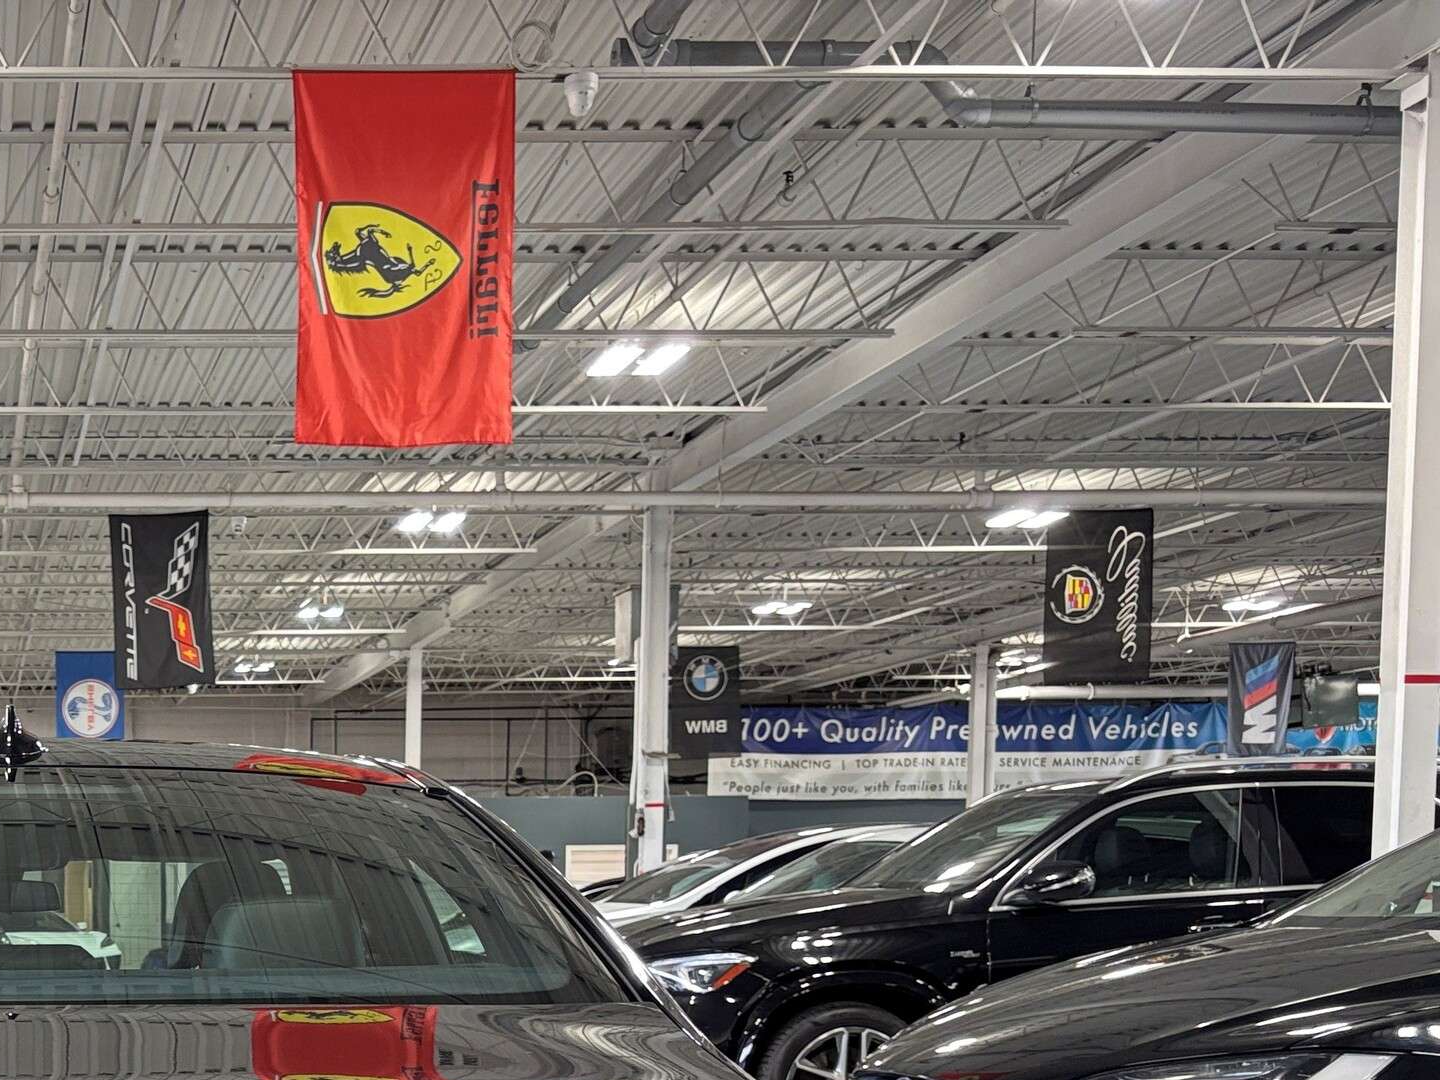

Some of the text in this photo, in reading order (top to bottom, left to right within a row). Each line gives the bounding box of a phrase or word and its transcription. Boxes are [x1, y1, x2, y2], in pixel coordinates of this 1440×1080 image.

[121, 522, 138, 681] CORVETTE
[741, 717, 809, 743] 100+
[820, 715, 920, 749] Quality
[1088, 711, 1199, 741] Vehicles
[730, 758, 760, 769] EASY
[764, 759, 831, 770] FINANCING
[855, 759, 879, 769] TOP
[883, 757, 935, 769] TRADE-IN
[999, 757, 1048, 768] SERVICE
[1052, 756, 1142, 769] MAINTENANCE
[776, 782, 801, 794] just
[804, 781, 827, 793] like
[831, 785, 858, 797] you,
[863, 780, 890, 793] with
[894, 780, 944, 794] families
